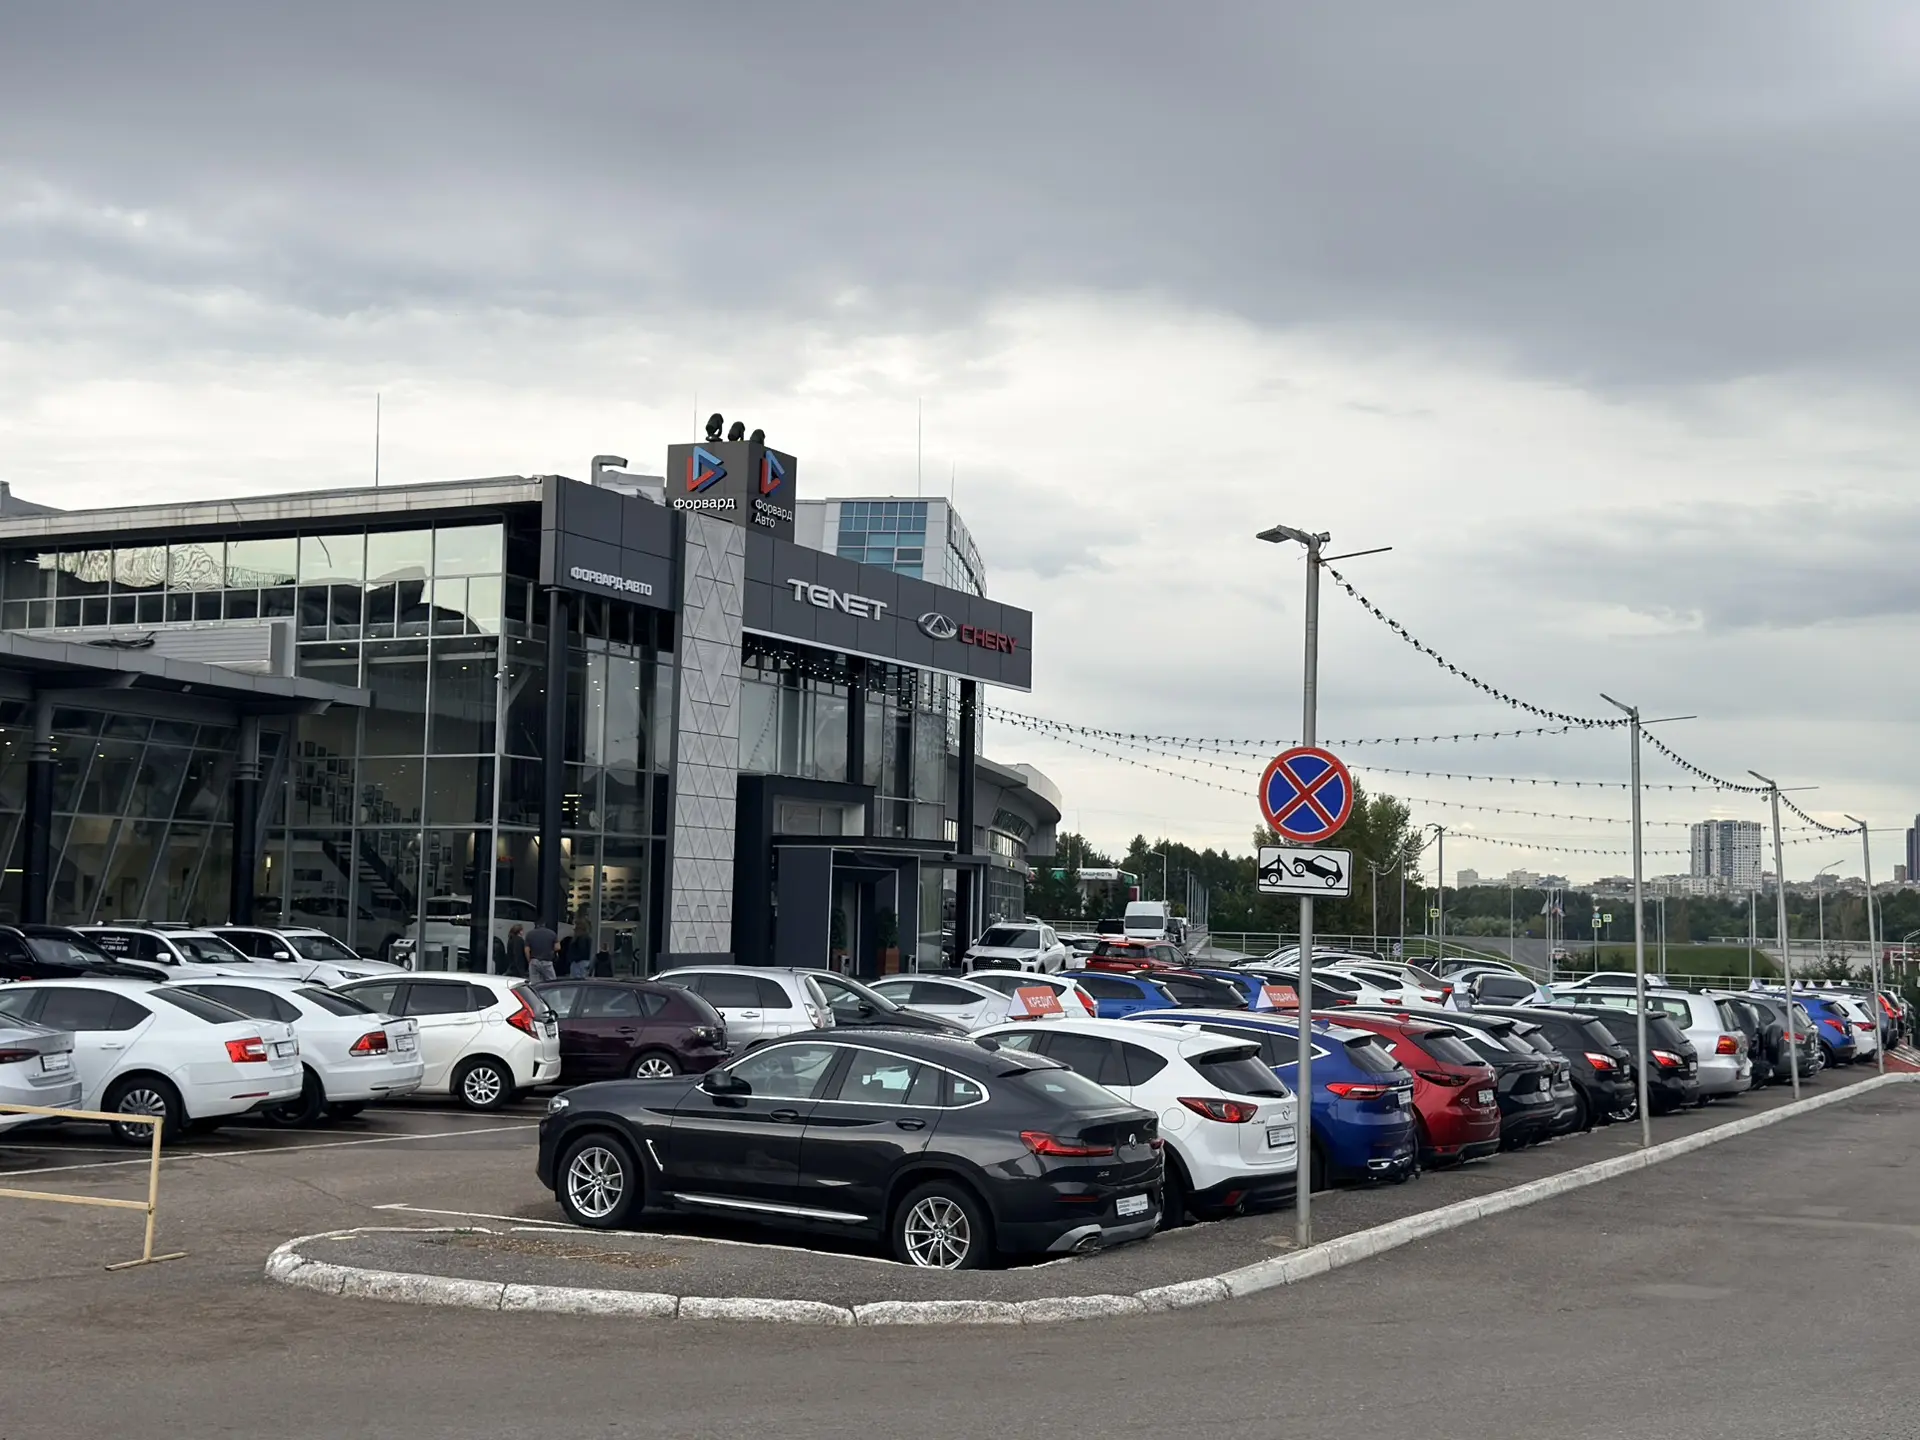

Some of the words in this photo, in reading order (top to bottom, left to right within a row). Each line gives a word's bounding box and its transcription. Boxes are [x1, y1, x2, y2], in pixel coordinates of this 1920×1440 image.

[673, 497, 735, 511] Форвард
[755, 498, 793, 522] Форвард
[754, 512, 776, 528] Авто
[570, 566, 653, 596] ФОРВАРД-АВТО
[786, 578, 888, 621] TENET
[960, 624, 1018, 654] CHERY
[1026, 995, 1056, 1008] КРЕДИТ
